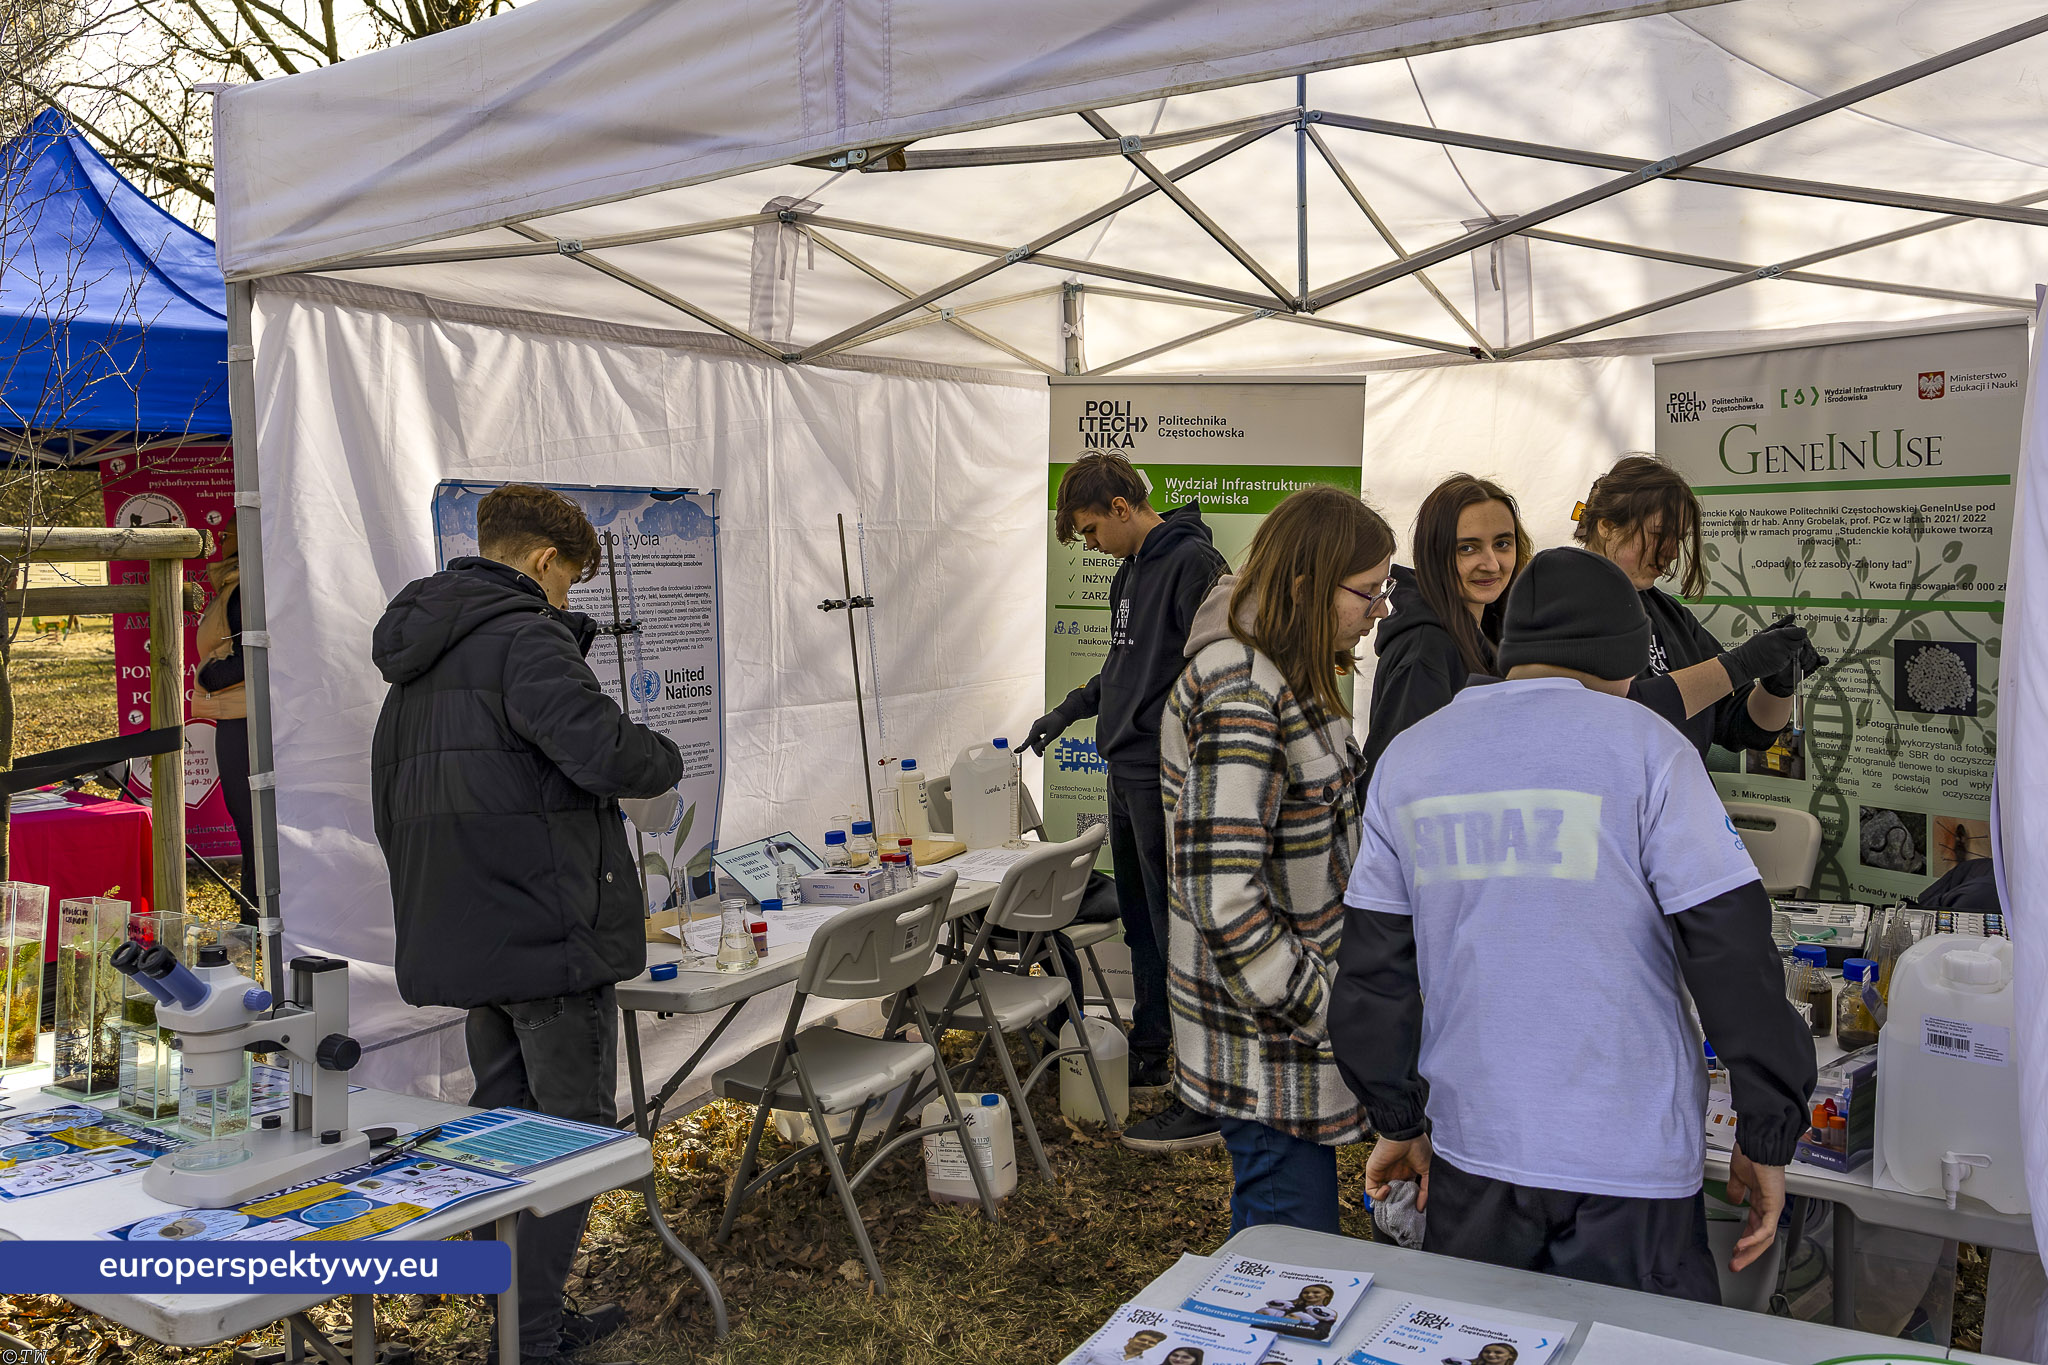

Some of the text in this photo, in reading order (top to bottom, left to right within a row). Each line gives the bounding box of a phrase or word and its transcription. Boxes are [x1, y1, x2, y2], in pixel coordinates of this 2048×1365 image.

[1950, 372, 2007, 382] Ministerstwo
[1824, 384, 1902, 396] Wydział Infrastruktury
[1950, 384, 1985, 392] Edukacji
[1992, 380, 2018, 389] Nauki
[1670, 391, 1696, 403] POLI
[1712, 396, 1753, 405] Politechnika
[1086, 400, 1131, 416] POLI
[1712, 403, 1764, 413] Częstochowska
[1158, 415, 1226, 426] Politechnika
[1671, 412, 1700, 423] NIKA
[1158, 427, 1244, 439] Częstochowska
[1085, 432, 1135, 448] NIKA
[1165, 477, 1217, 492] Wydział
[197, 490, 214, 498] raka
[1171, 490, 1249, 505] Środowiska
[1790, 507, 1838, 515] Politechniki
[1841, 505, 1918, 515] Częstochowskiej
[1920, 504, 1972, 512] GeneInUse
[1976, 503, 1996, 513] pod
[1762, 518, 1780, 526] hab.
[1782, 517, 1804, 527] Anny
[1807, 517, 1847, 525] Grobelak,
[1850, 516, 1870, 524] prof.
[1873, 516, 1891, 524] PCz
[1935, 515, 1960, 523] 2021/
[1963, 514, 1986, 522] 2022
[1721, 527, 1748, 537] projekt
[1793, 527, 1833, 537] programu
[1835, 527, 1889, 535] „Studenckie
[1959, 526, 1993, 535] tworzą
[1751, 560, 1789, 569] „Odpady
[1804, 560, 1817, 568] też
[1892, 560, 1912, 569] ład”
[1870, 581, 1897, 589] Kwota
[1804, 613, 1841, 623] obejmuje
[1852, 616, 1888, 624] zadania:
[1084, 625, 1107, 633] Udział
[664, 666, 705, 683] United
[665, 684, 712, 700] Nations
[1866, 720, 1959, 734] Fotogranule tlenowe
[1900, 739, 1962, 751] wykorzystania
[1909, 750, 1928, 759] SBR
[1934, 753, 1945, 761] do
[1848, 755, 1987, 777] Fotogranule tlenowe to skupiska
[1863, 768, 1882, 777] które
[1893, 773, 1930, 785] powstają
[1894, 784, 1929, 794] ścieków
[1742, 791, 1791, 803] Mikroplastik
[725, 850, 760, 865] STANOWISKO
[1859, 885, 1887, 898] Owady
[1224, 1274, 1266, 1285] zaprasza
[1279, 1274, 1333, 1284] Częstochowska
[1281, 1270, 1324, 1279] Politechnika
[1234, 1281, 1263, 1290] studia
[1216, 1287, 1245, 1297] pcz.pl
[1194, 1304, 1240, 1319] Informator
[1171, 1323, 1226, 1338] Częstochowska
[1174, 1319, 1217, 1331] Politechnika
[1461, 1324, 1508, 1338] Politechnika
[1399, 1324, 1443, 1339] zaprasza
[1458, 1328, 1518, 1344] Częstochowska
[1389, 1339, 1419, 1351] pcz.pl
[1408, 1333, 1439, 1345] studia
